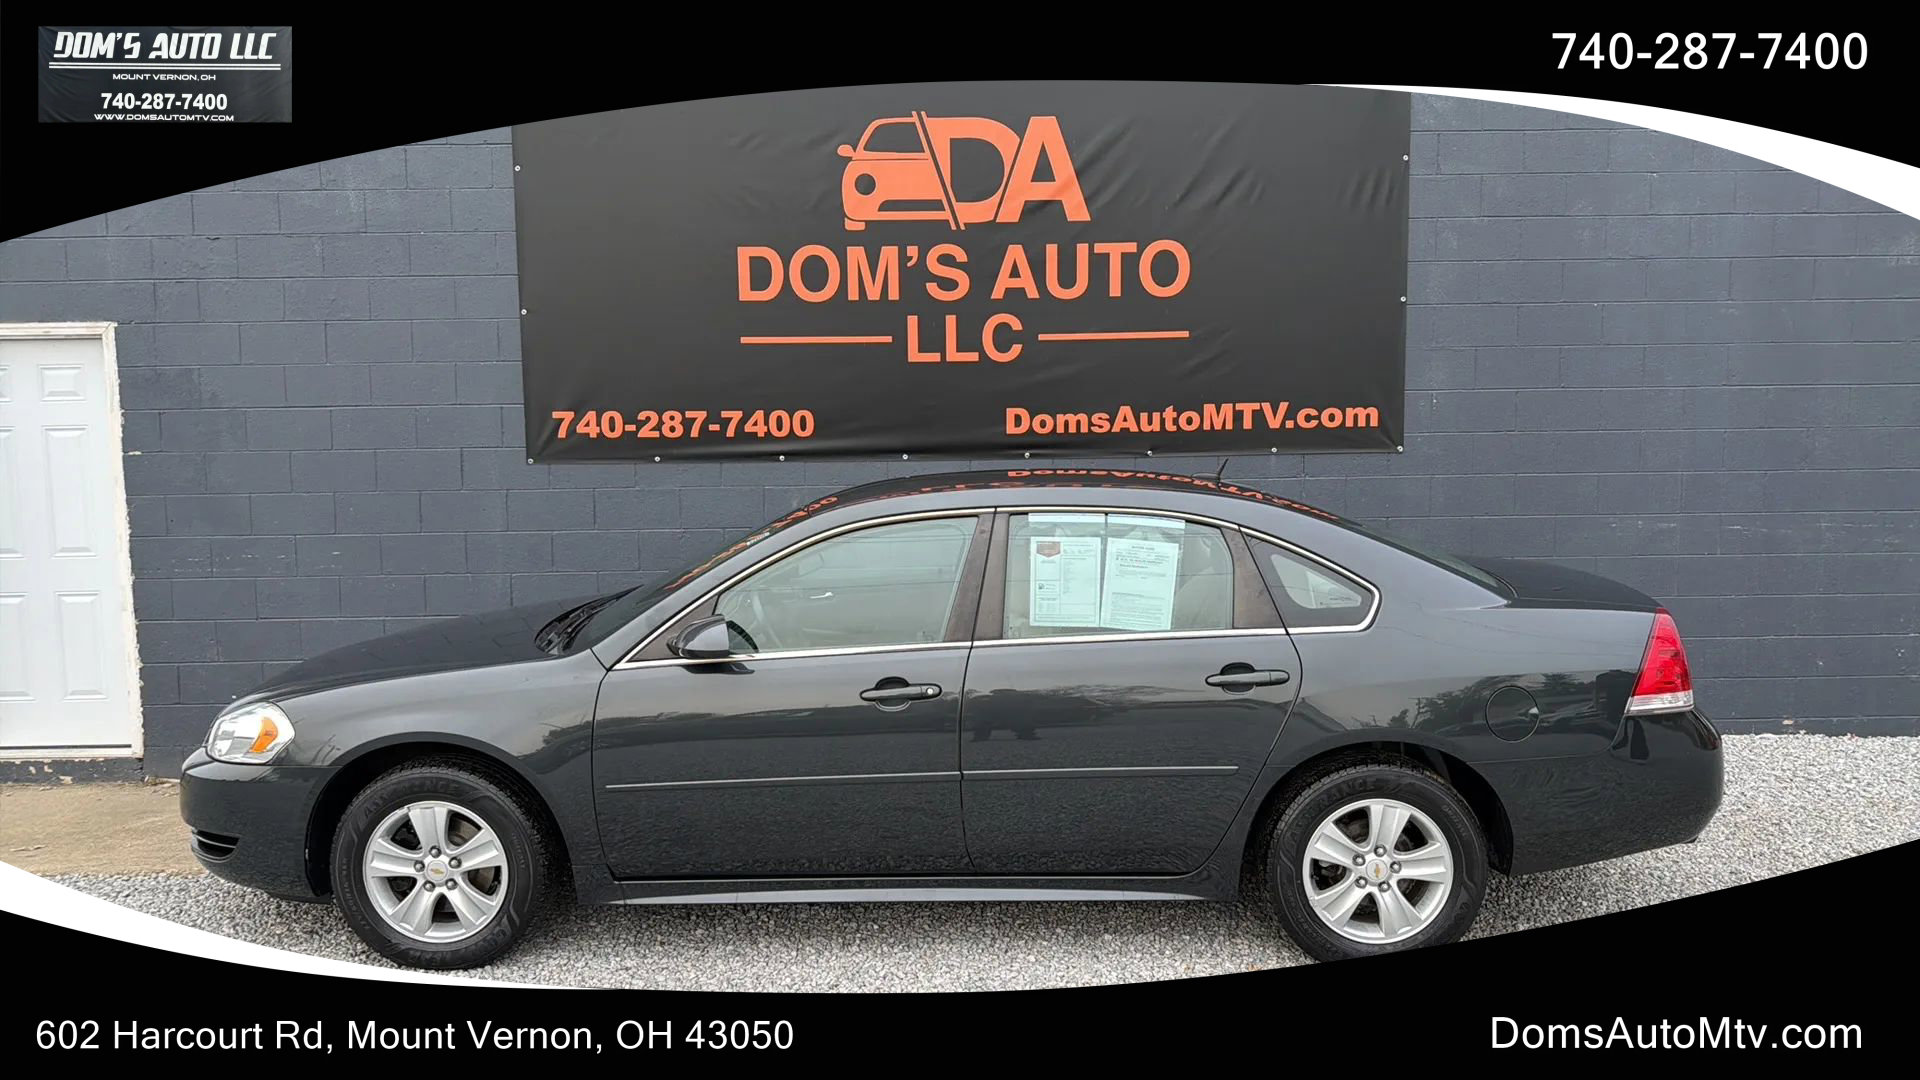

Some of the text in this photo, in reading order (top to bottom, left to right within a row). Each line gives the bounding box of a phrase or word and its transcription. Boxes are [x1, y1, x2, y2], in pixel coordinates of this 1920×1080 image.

[736, 239, 1192, 305] DOM'S AUTO
[906, 312, 1025, 364] LLC
[551, 409, 816, 440] 740-287-7400
[1005, 401, 1381, 437] DomsAutoMTV.com
